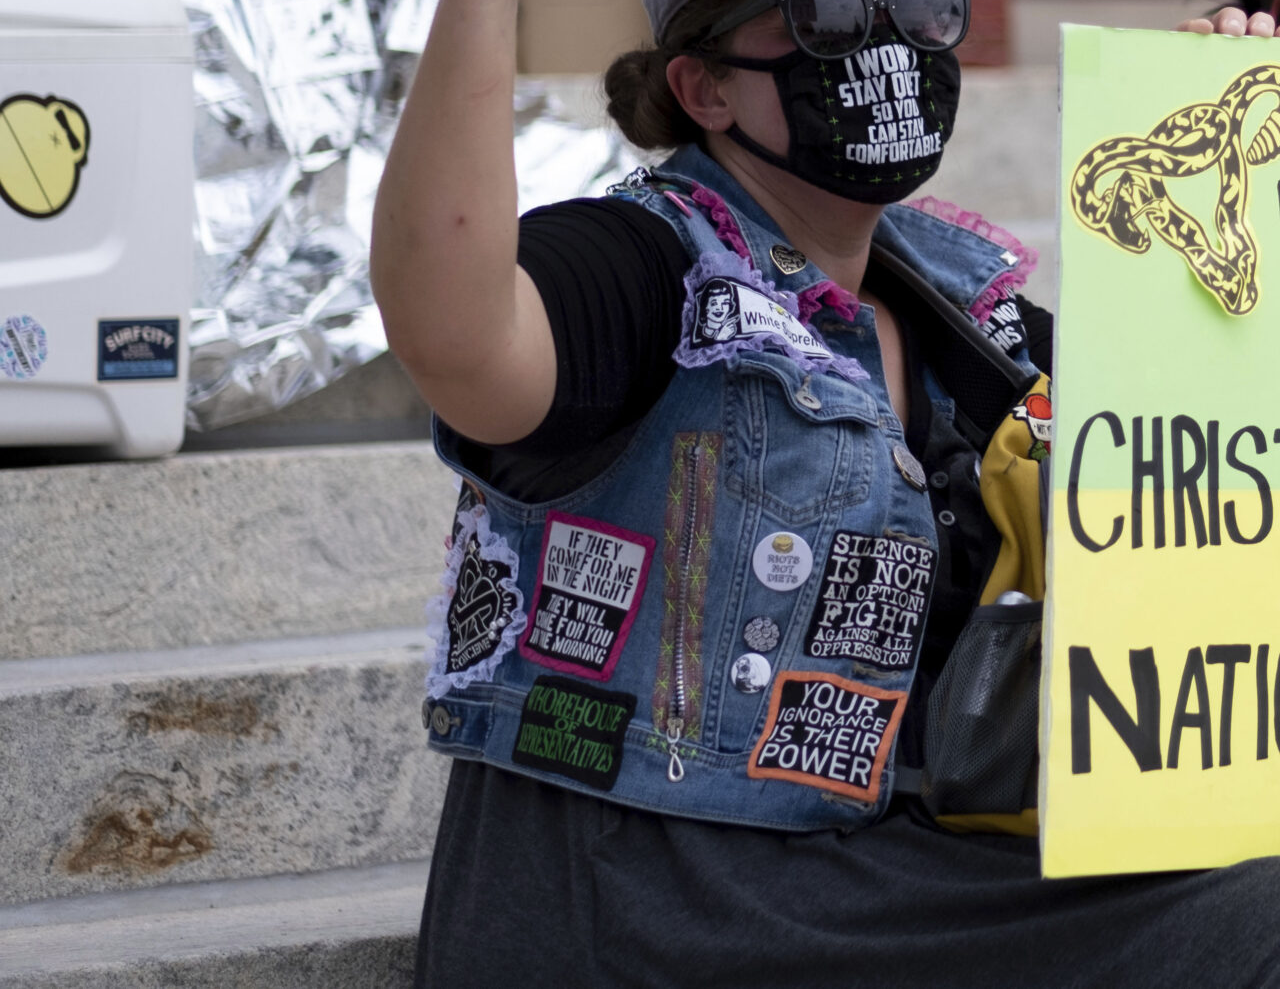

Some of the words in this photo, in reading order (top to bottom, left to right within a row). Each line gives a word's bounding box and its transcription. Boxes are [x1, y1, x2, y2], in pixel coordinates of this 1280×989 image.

[844, 57, 856, 81] I
[838, 74, 886, 107] STAY
[872, 101, 893, 123] SO
[894, 97, 919, 119] YOU
[868, 122, 897, 143] CAN
[898, 116, 924, 140] STAY
[845, 131, 941, 164] COMFORTABLE
[743, 310, 783, 330] White
[768, 301, 794, 323] Fck
[568, 530, 583, 549] IF
[584, 534, 623, 560] THEY
[834, 533, 933, 569] SILENCE
[548, 546, 583, 569] COME
[579, 554, 612, 579] FOR
[614, 564, 637, 586] ME
[767, 554, 800, 565] RIOTS
[772, 564, 795, 573] NOT
[547, 564, 560, 582] IN
[582, 575, 631, 603] NIGHT
[767, 573, 799, 584] DIETS
[827, 555, 861, 583] IS
[872, 559, 930, 596] NOT
[823, 584, 849, 600] AN
[855, 584, 925, 612] OPTION!
[575, 602, 606, 626] WILL
[818, 600, 918, 638] FIGHT
[556, 617, 586, 639] FOR
[585, 626, 614, 648] YOU
[813, 627, 878, 642] AGAINST
[882, 636, 913, 651] ALL
[551, 635, 607, 664] MORNING
[811, 641, 911, 665] OPPRESSION
[801, 682, 879, 716] YOUR
[554, 718, 579, 734] OF
[778, 707, 887, 733] IGNORANCE
[768, 725, 795, 743] IS
[803, 726, 880, 757] THEIR
[758, 743, 872, 786] POWER
